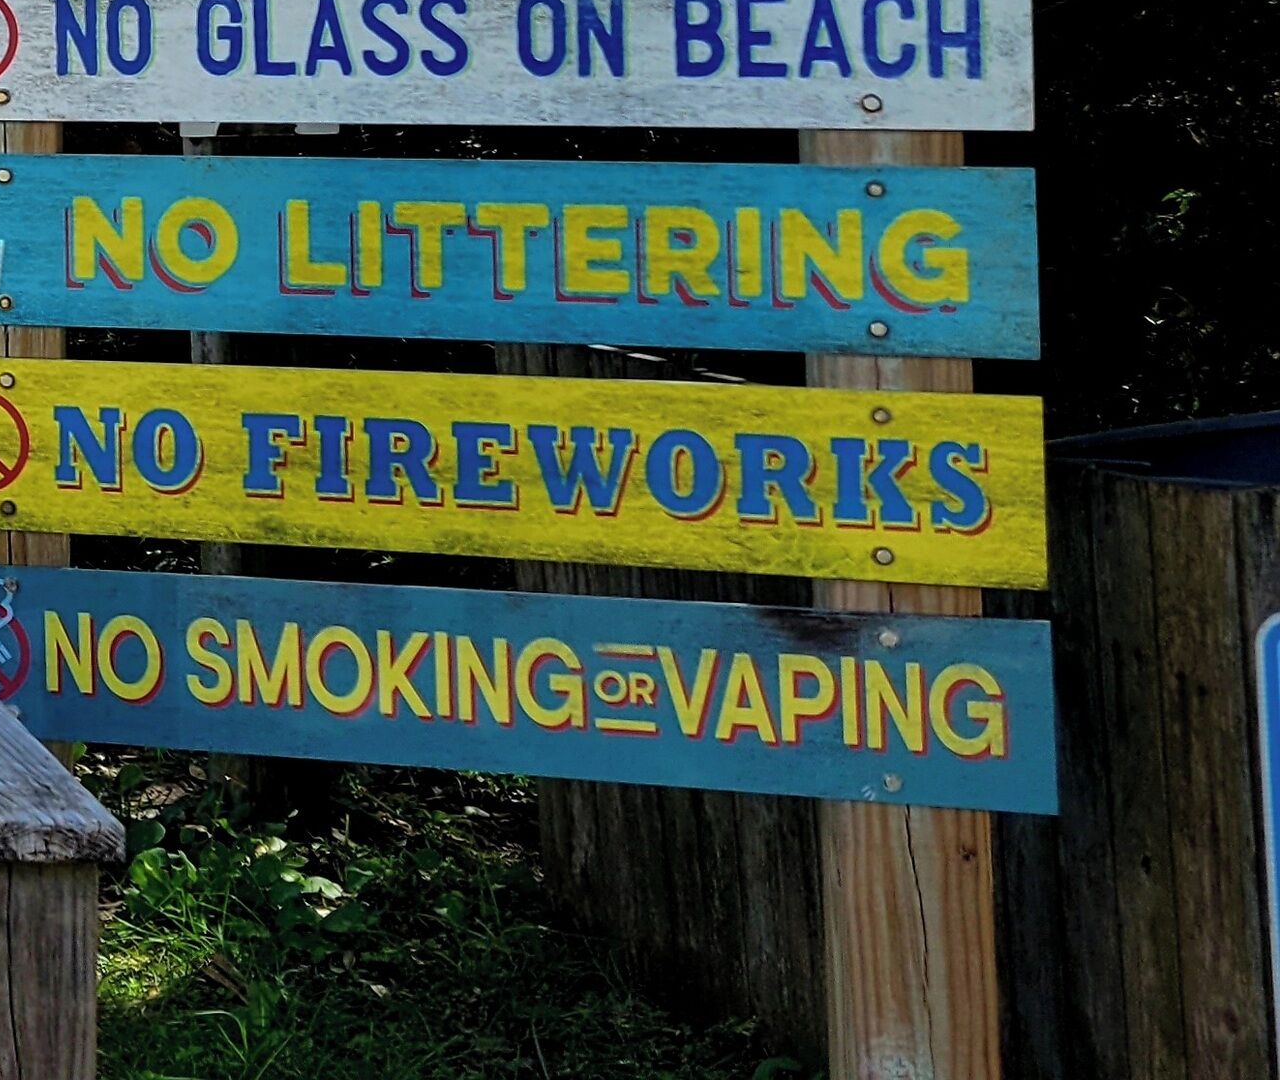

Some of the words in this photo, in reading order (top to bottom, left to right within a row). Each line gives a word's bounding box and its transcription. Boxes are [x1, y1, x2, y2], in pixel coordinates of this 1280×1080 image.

[65, 195, 239, 293] NO
[278, 198, 970, 313] LITTERING
[52, 405, 205, 496] NO
[241, 411, 993, 537] FIREWORKS
[44, 610, 166, 704] NO
[185, 616, 586, 731] SMOKING
[593, 669, 657, 705] OR
[657, 644, 1009, 759] VAPING
